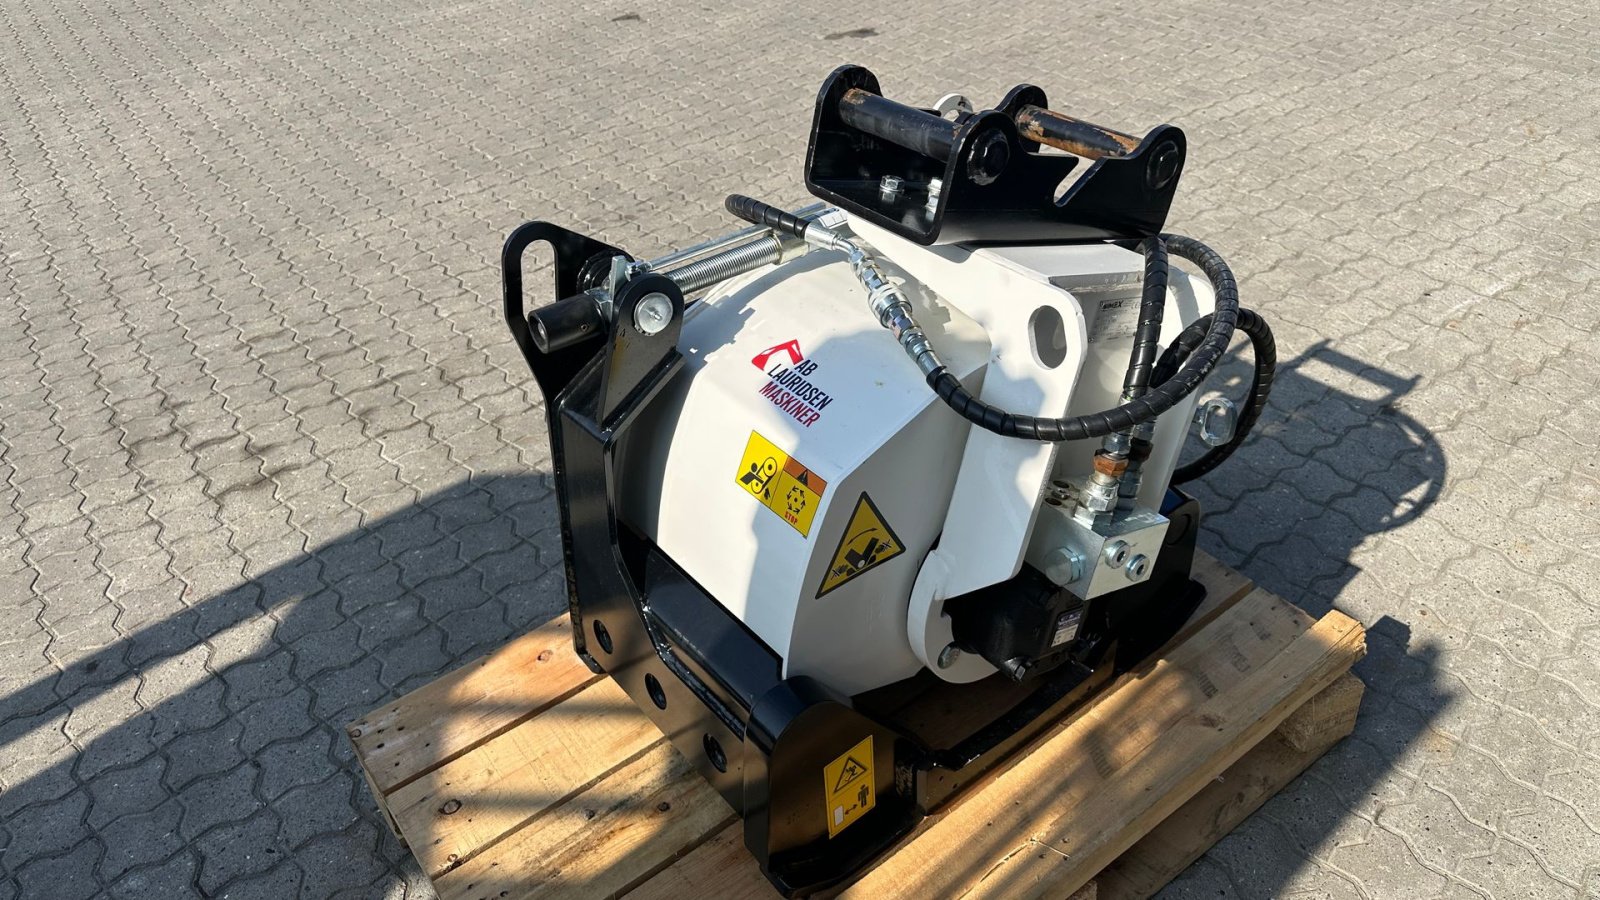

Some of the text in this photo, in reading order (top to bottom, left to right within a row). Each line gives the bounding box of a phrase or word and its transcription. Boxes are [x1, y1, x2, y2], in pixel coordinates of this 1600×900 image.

[794, 359, 818, 376] AB
[767, 363, 833, 411] LAURIDSEN
[758, 381, 821, 428] MASKINER
[784, 510, 798, 525] STOP
